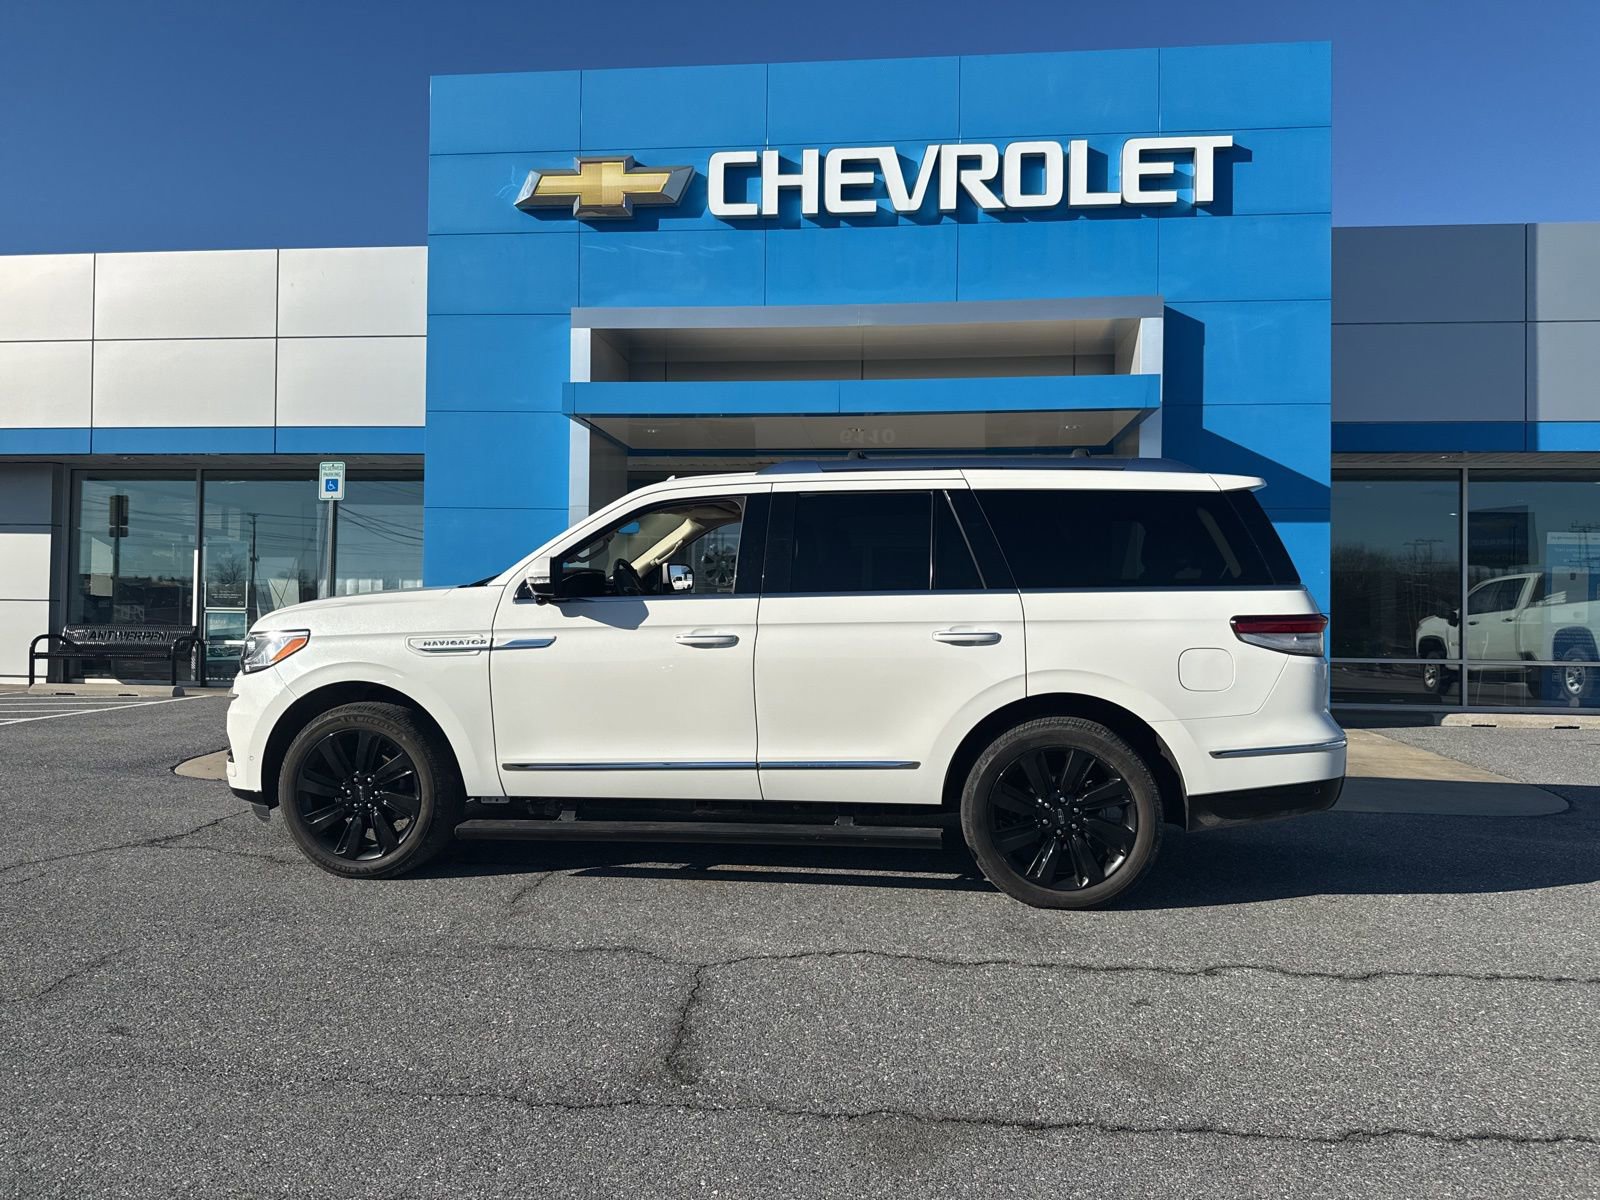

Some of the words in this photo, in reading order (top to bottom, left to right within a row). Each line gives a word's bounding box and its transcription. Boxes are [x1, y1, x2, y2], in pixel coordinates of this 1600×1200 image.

[708, 135, 1234, 219] CHEVROLET
[88, 630, 168, 641] ANTWERPEN
[423, 639, 487, 647] NAVIGATOR
